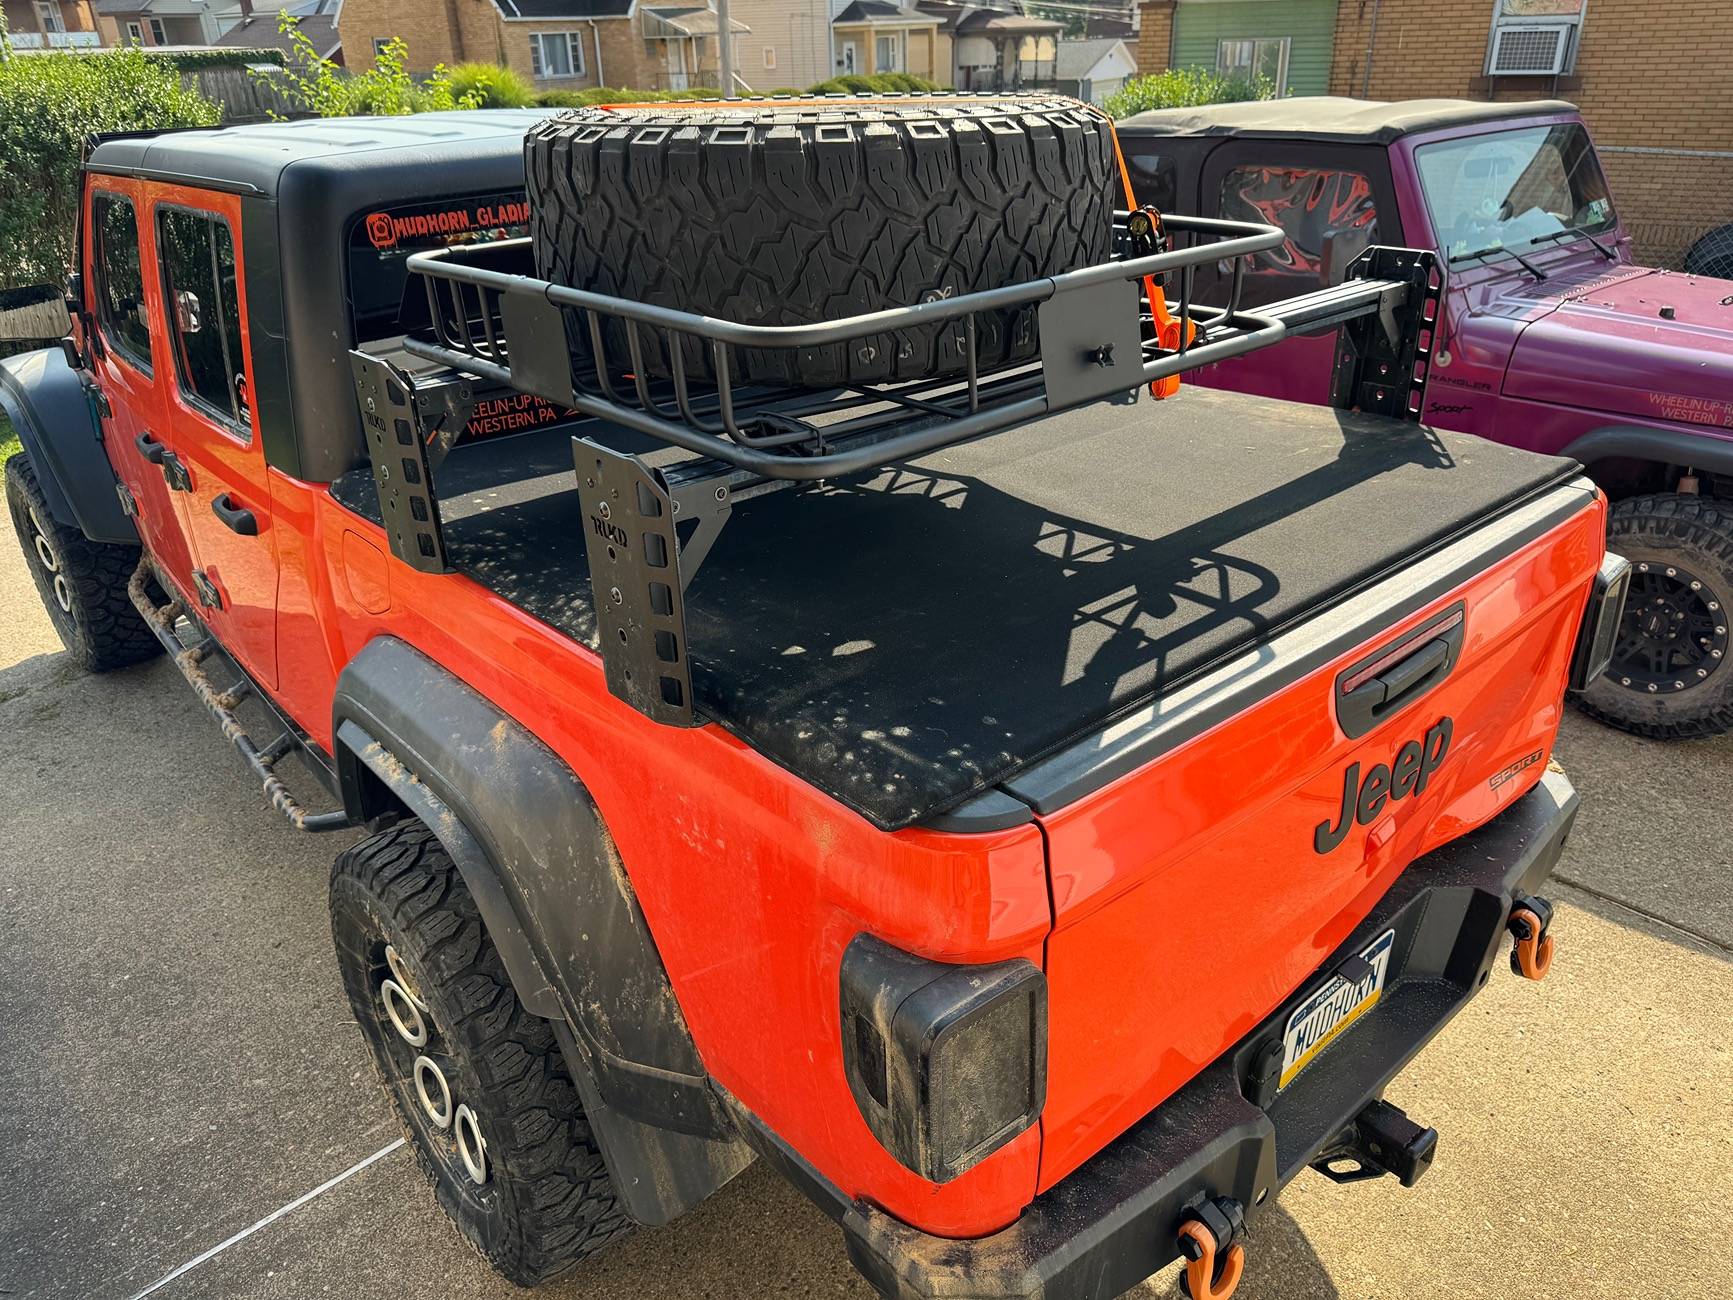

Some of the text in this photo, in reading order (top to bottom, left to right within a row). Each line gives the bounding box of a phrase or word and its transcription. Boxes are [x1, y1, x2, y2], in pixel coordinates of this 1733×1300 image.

[393, 202, 529, 239] MUDHORN_GLADIA
[1430, 374, 1493, 391] RANGLER
[538, 407, 557, 422] PA
[1649, 392, 1733, 417] WHEELIN UP-R
[1661, 406, 1717, 425] WESTERN
[1489, 747, 1544, 792] SPORT
[1314, 716, 1454, 855] Jeep
[1292, 957, 1382, 1063] MUDHORN
